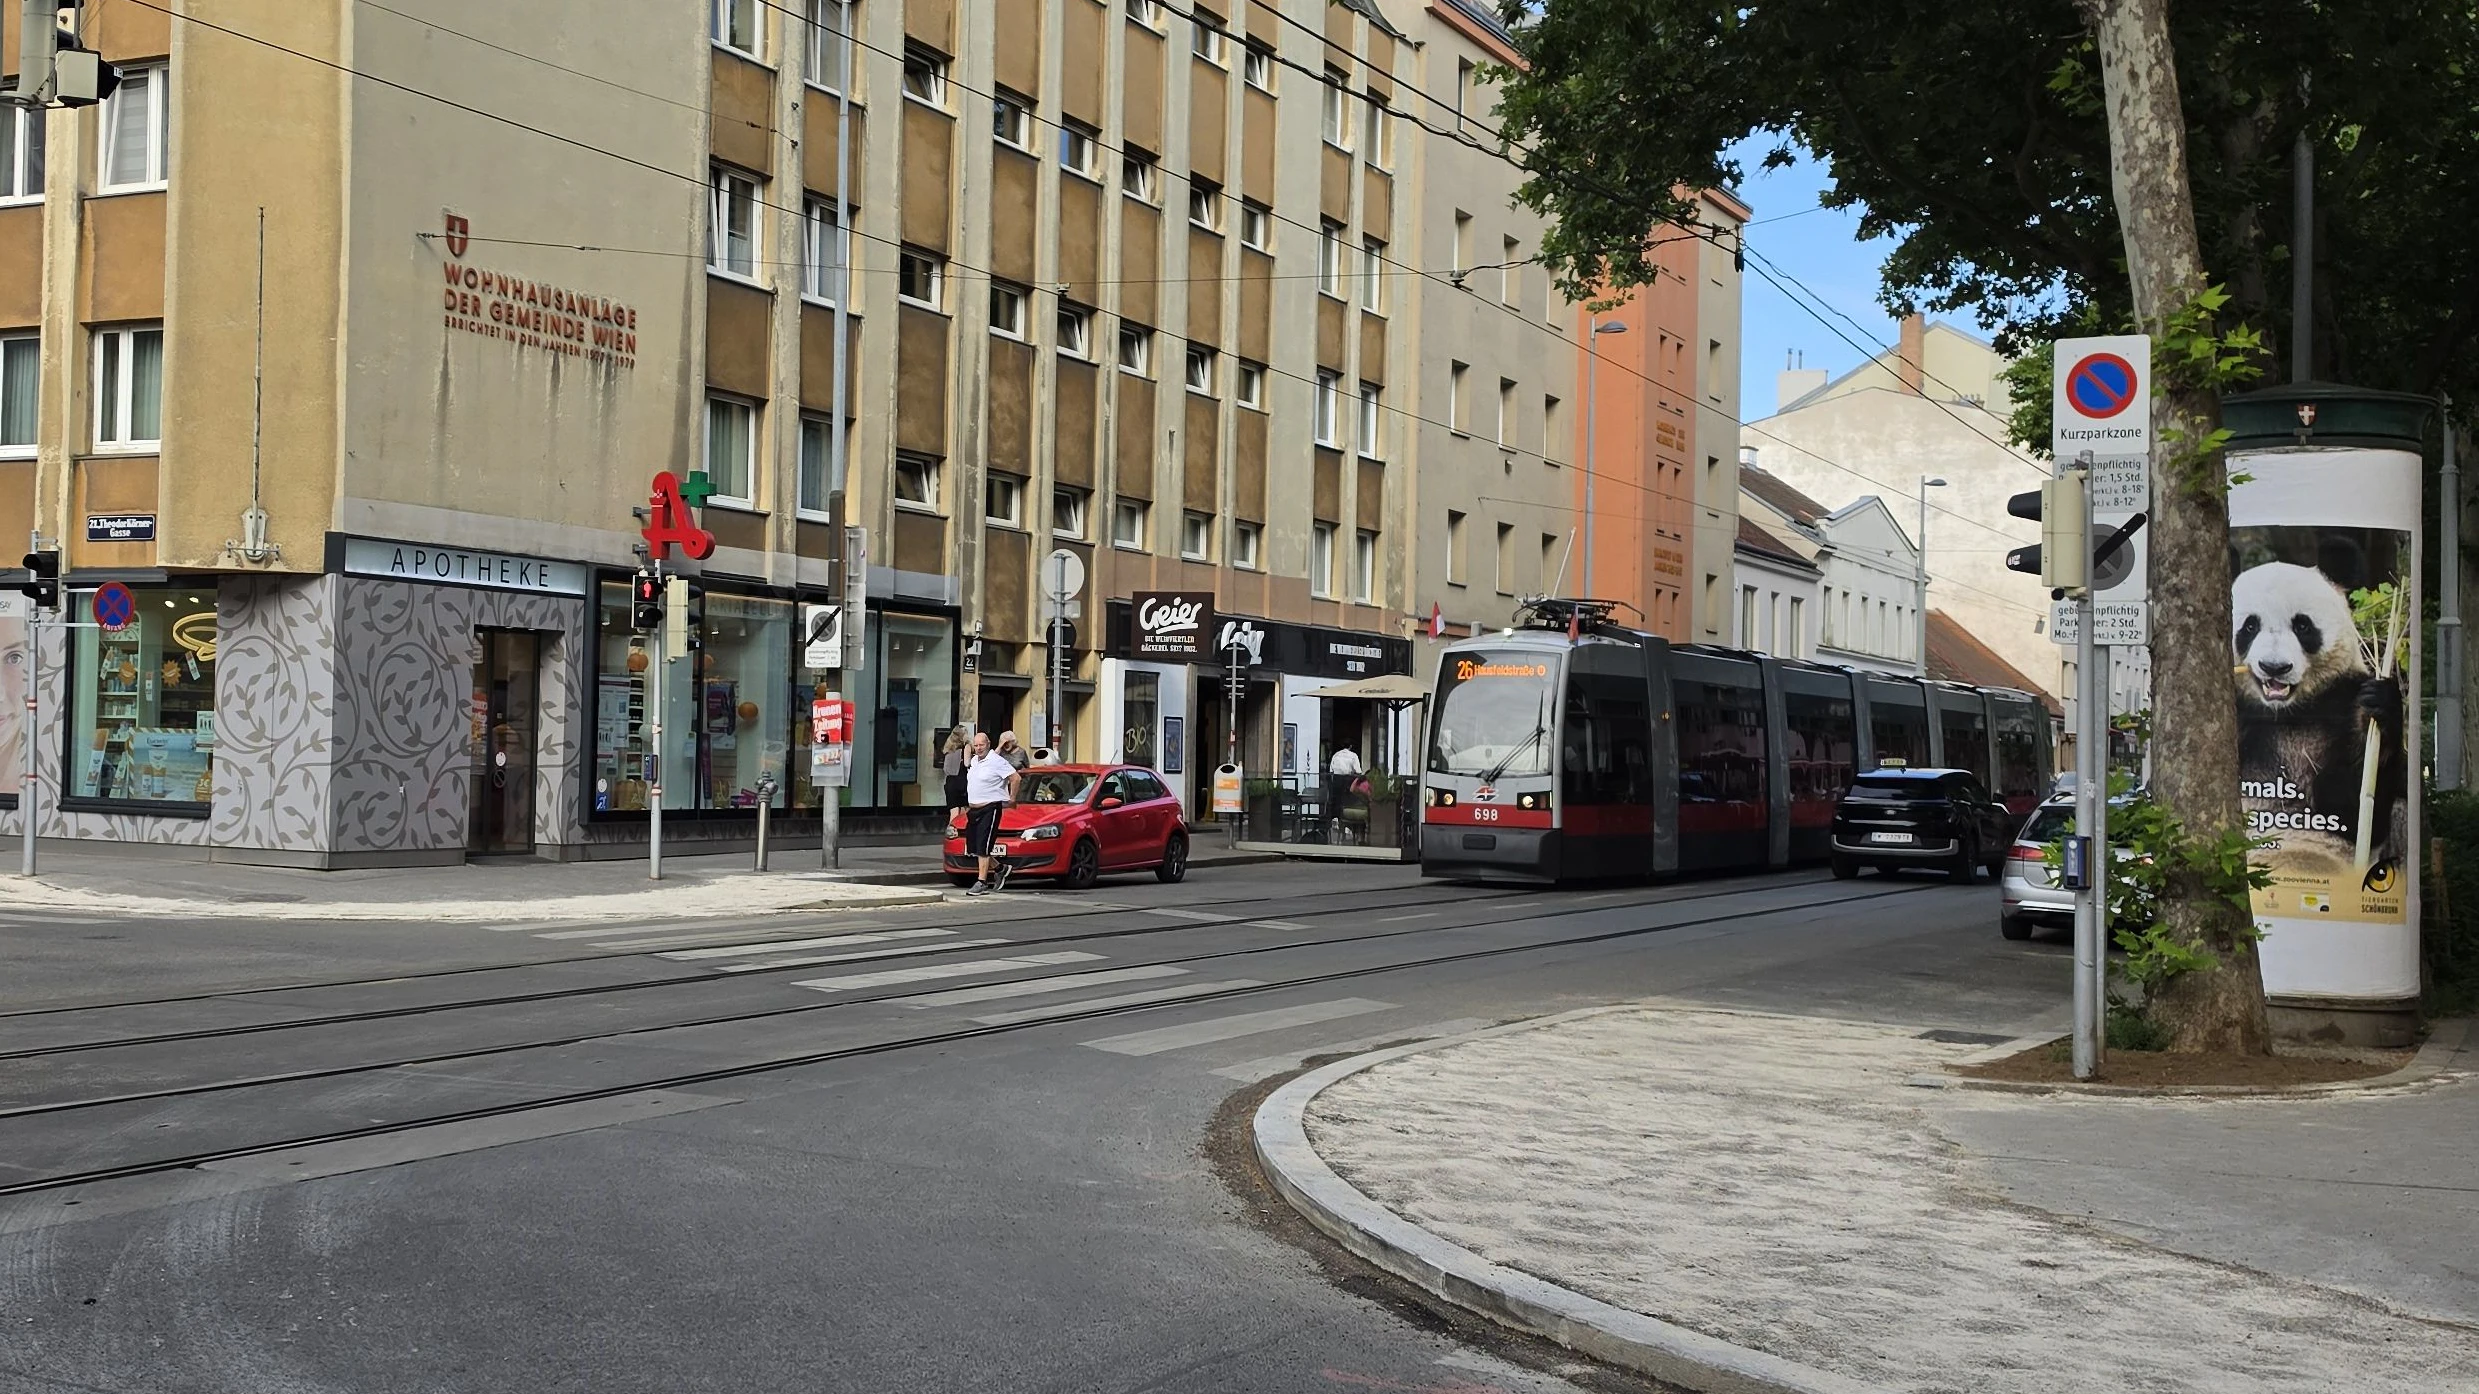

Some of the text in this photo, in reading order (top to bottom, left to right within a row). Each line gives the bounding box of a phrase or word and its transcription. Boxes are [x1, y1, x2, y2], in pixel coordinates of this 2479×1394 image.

[443, 261, 636, 330] WOHNHAUSANLAGE
[445, 288, 636, 356] DER GEMEINDE WIEN
[444, 315, 501, 338] ERRICHTET
[505, 328, 516, 342] IN
[520, 332, 541, 348] DEN
[544, 339, 581, 357] JAHREN
[2060, 427, 2142, 441] Kurzparkzone
[2110, 473, 2122, 483] 1,5
[2125, 472, 2143, 482] Std.
[109, 528, 131, 537] Gasse
[391, 548, 549, 588] APOTHEKE
[1140, 596, 1203, 631] Geier
[2111, 618, 2116, 627] 2
[2119, 618, 2137, 628] Std.
[1457, 660, 1474, 680] 26
[1474, 665, 1535, 676] Hausfeldstraße
[812, 704, 842, 719] Kronen
[813, 717, 843, 733] Zeitung
[1474, 807, 1498, 822] 698
[2247, 807, 2348, 832] species.
